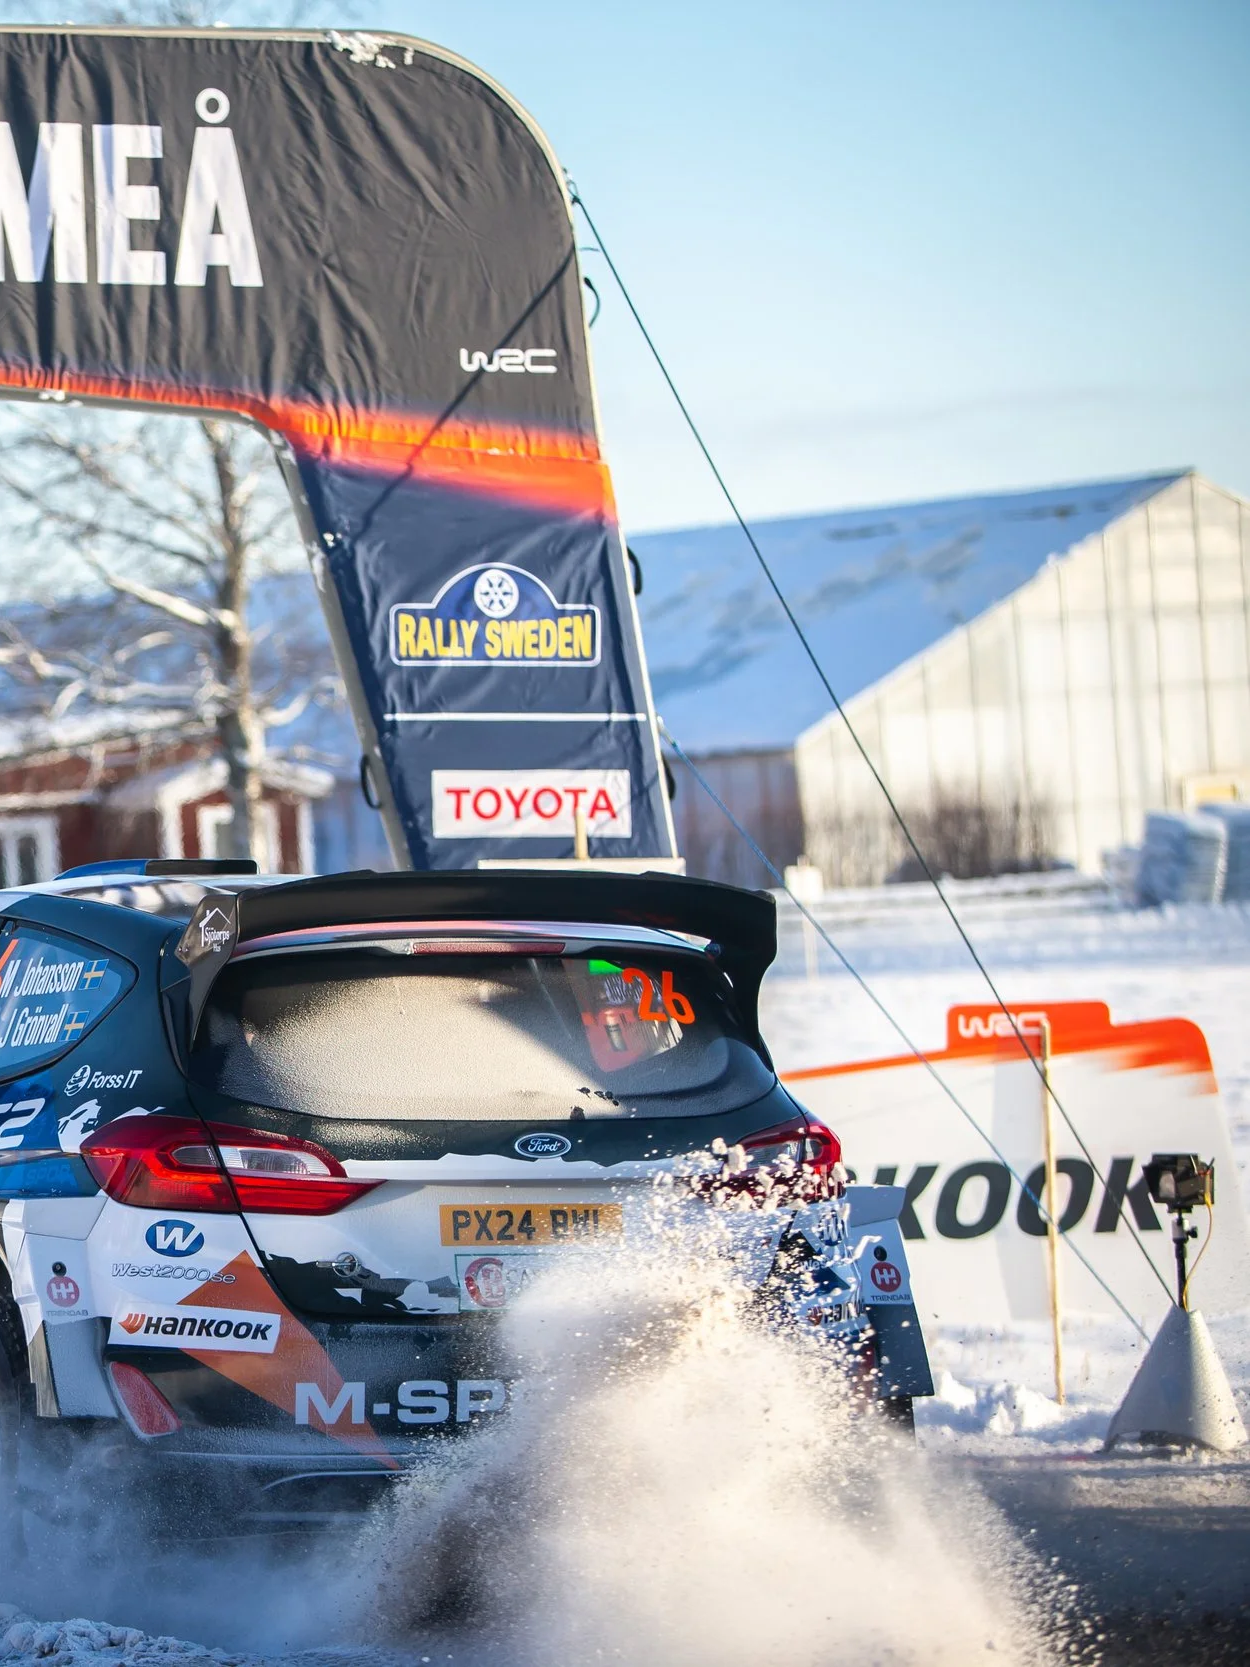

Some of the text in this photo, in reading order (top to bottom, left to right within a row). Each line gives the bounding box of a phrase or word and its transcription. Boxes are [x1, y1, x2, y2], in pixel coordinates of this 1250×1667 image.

[459, 348, 558, 374] WRC
[398, 613, 592, 659] RALLY SWEDEN
[446, 787, 618, 821] TOYOTA
[13, 957, 85, 996] Johansson
[622, 967, 696, 1025] 26
[11, 1003, 70, 1047] Grönvall
[87, 1069, 143, 1089] Forss IT
[526, 1138, 561, 1153] Ford
[847, 1156, 1163, 1242] KOOK
[452, 1209, 536, 1241] PX24
[143, 1314, 273, 1341] HANKOOK
